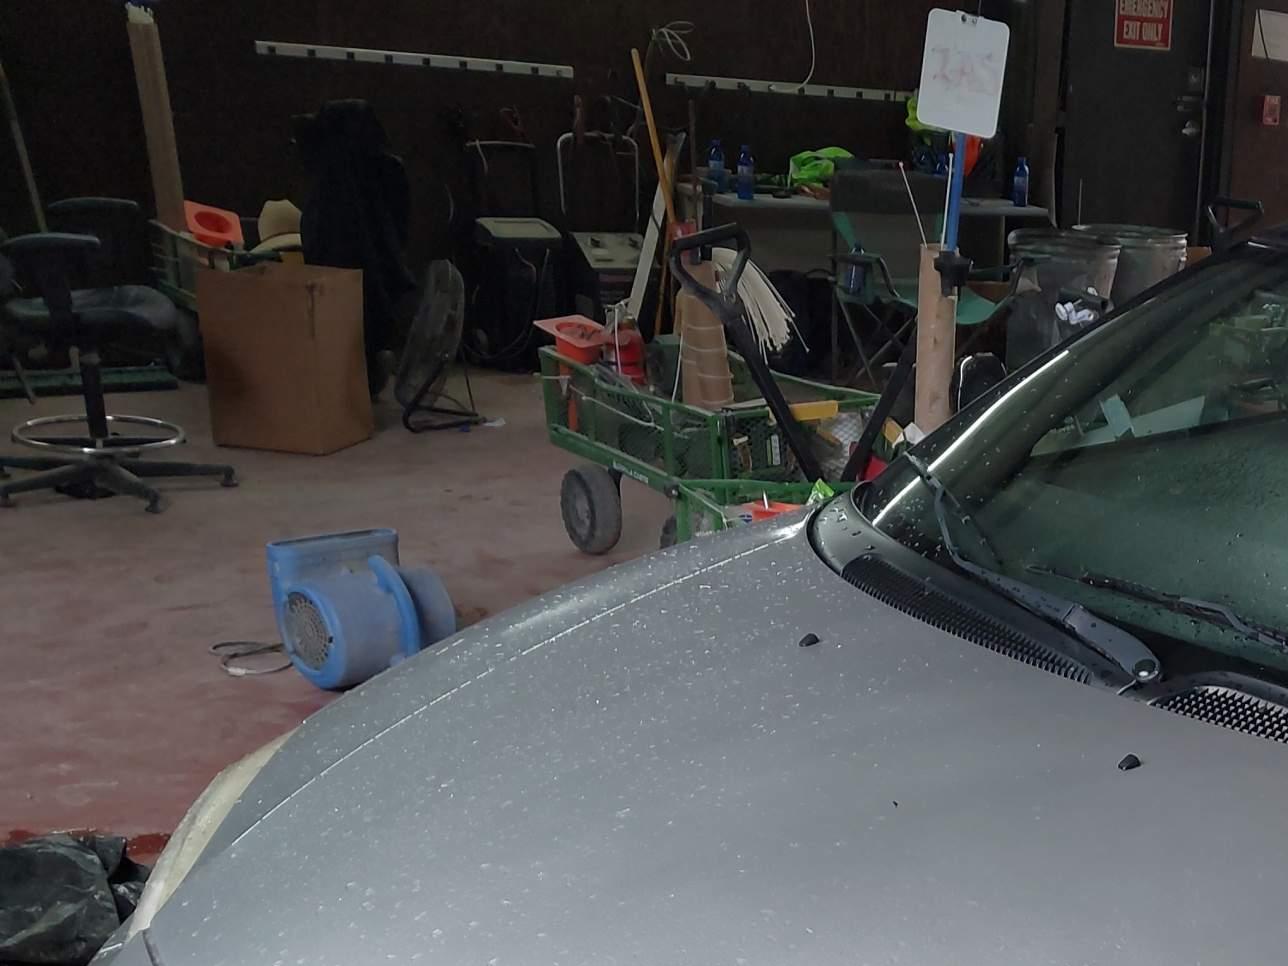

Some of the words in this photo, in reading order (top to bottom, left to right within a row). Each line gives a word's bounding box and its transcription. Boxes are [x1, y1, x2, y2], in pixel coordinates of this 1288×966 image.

[1120, 0, 1169, 18] EMERGENCY
[1123, 21, 1141, 40] EXIT
[1142, 23, 1163, 41] ONLY
